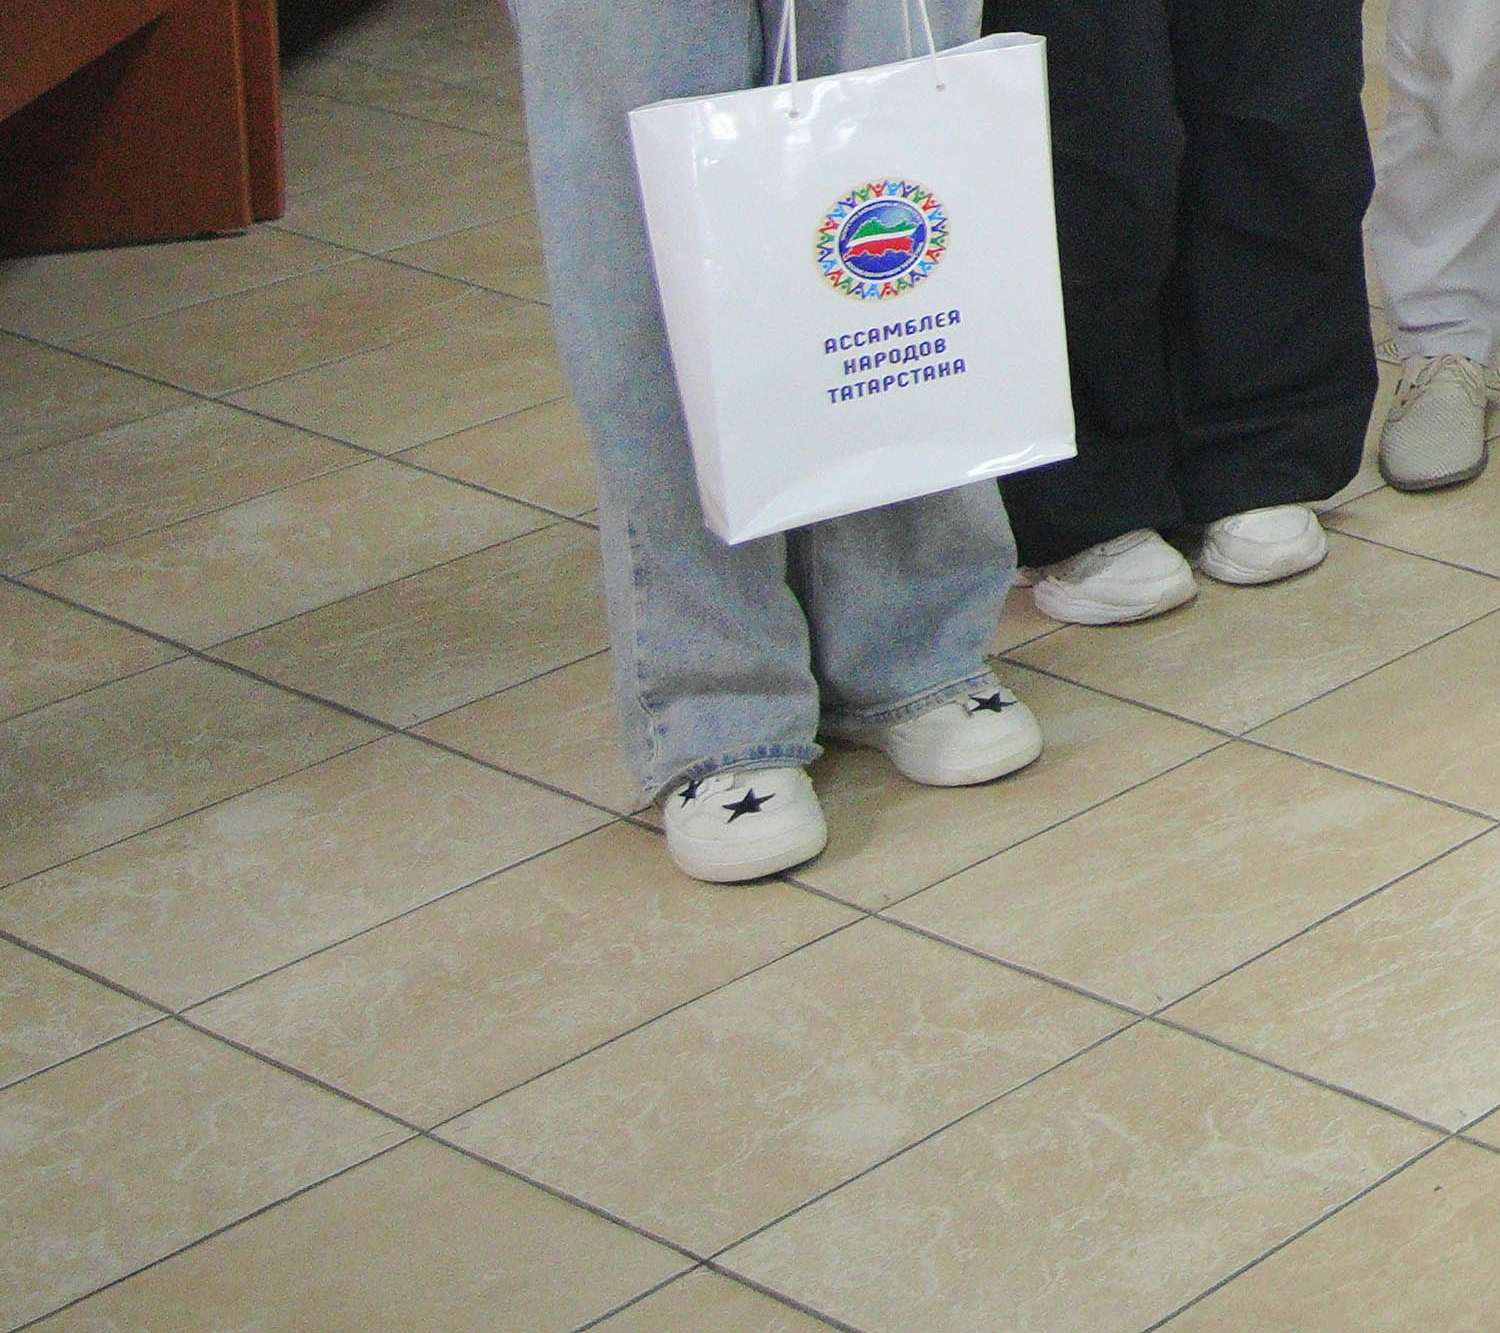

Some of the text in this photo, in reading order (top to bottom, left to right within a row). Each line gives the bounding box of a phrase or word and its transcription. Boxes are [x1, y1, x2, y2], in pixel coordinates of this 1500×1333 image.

[823, 309, 961, 355] АССАМБЛЕЯ
[843, 337, 947, 375] НАРОДОВ
[827, 358, 967, 405] ТАТАРСТАНА
